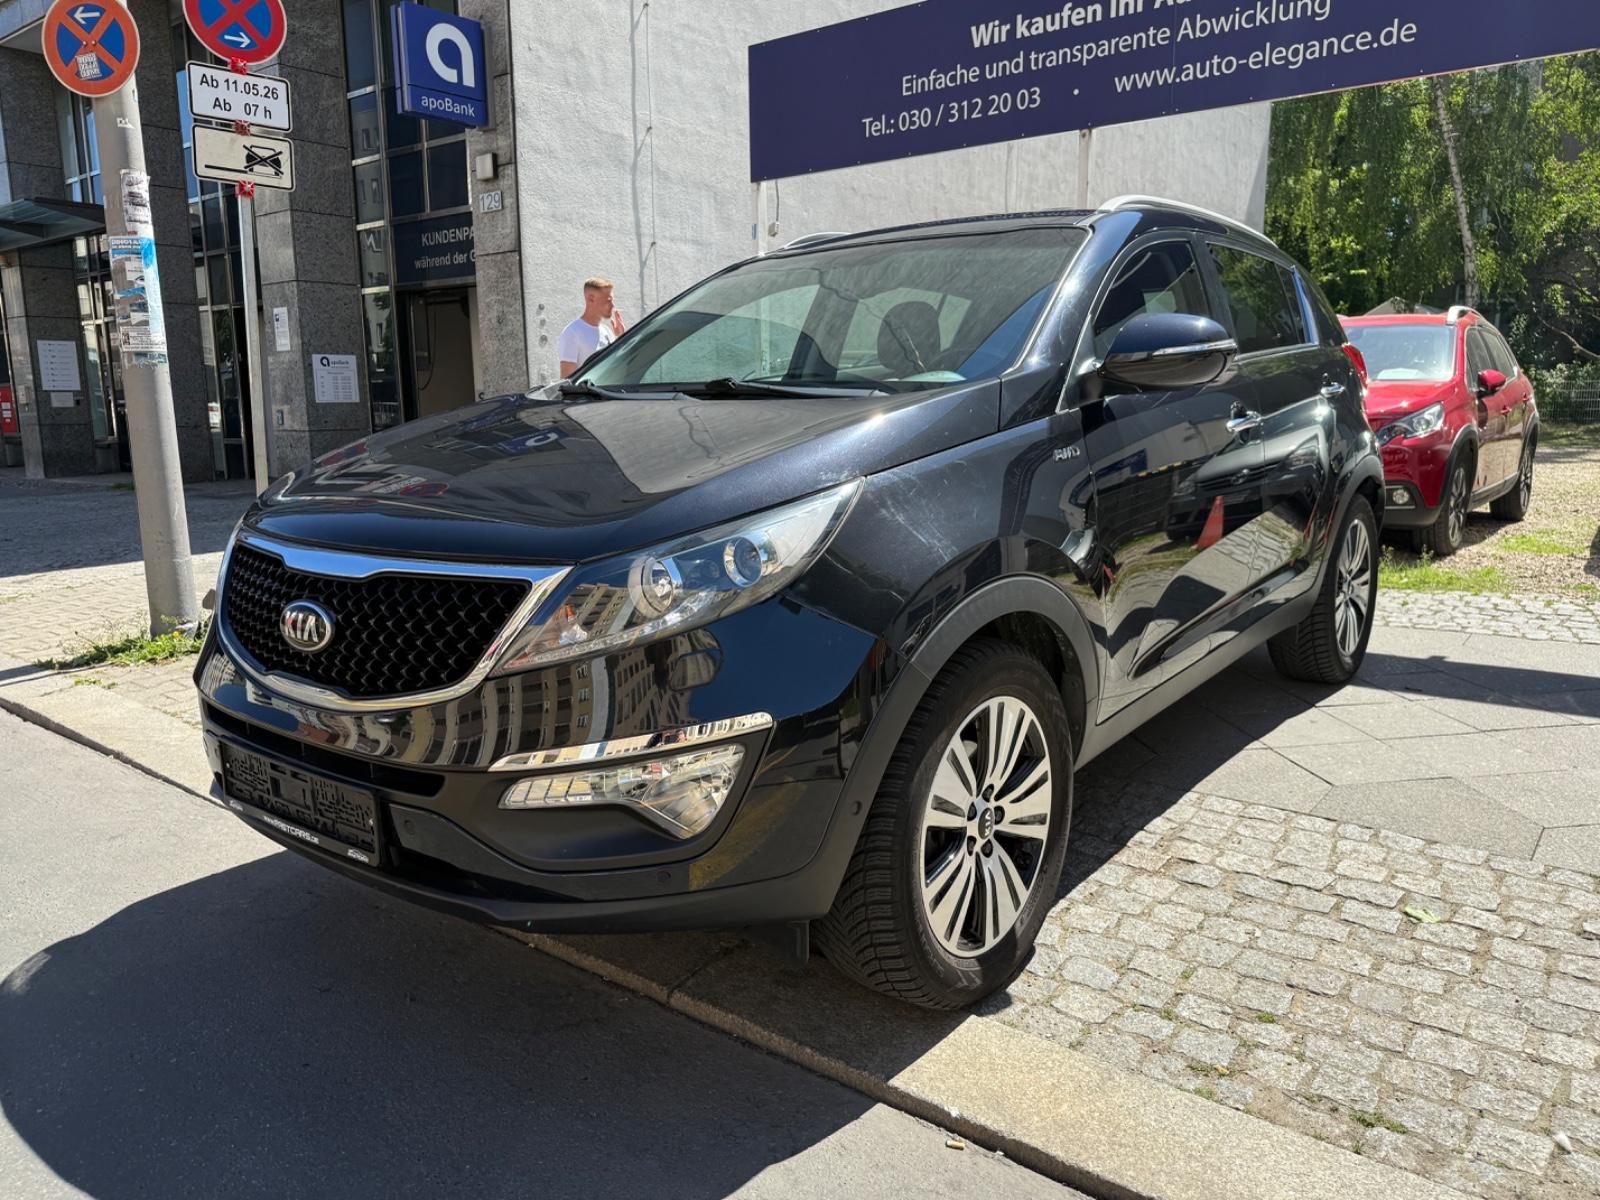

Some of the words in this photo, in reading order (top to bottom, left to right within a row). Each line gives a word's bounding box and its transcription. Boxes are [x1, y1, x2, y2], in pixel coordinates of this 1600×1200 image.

[970, 21, 1011, 48] Wir
[1015, 3, 1102, 39] kaufen
[902, 64, 980, 96] Einfache
[985, 51, 1024, 79] und
[1029, 26, 1170, 66] transparente
[1177, 0, 1332, 42] Abwicklung
[200, 73, 219, 89] Ab
[223, 78, 279, 100] 11.05.26
[862, 114, 895, 138] Tel.:
[898, 107, 931, 132] 030
[935, 104, 944, 127] /
[948, 97, 982, 123] 312
[987, 92, 1012, 117] 20
[1016, 86, 1041, 110] 03
[1114, 18, 1417, 93] www.auto-elegance.de
[213, 97, 232, 112] Ab
[244, 102, 259, 116] 07
[264, 106, 272, 120] h
[421, 96, 475, 117] apoBank
[480, 192, 501, 211] 129
[414, 252, 451, 269] während
[453, 251, 468, 264] der
[284, 610, 319, 643] KIA
